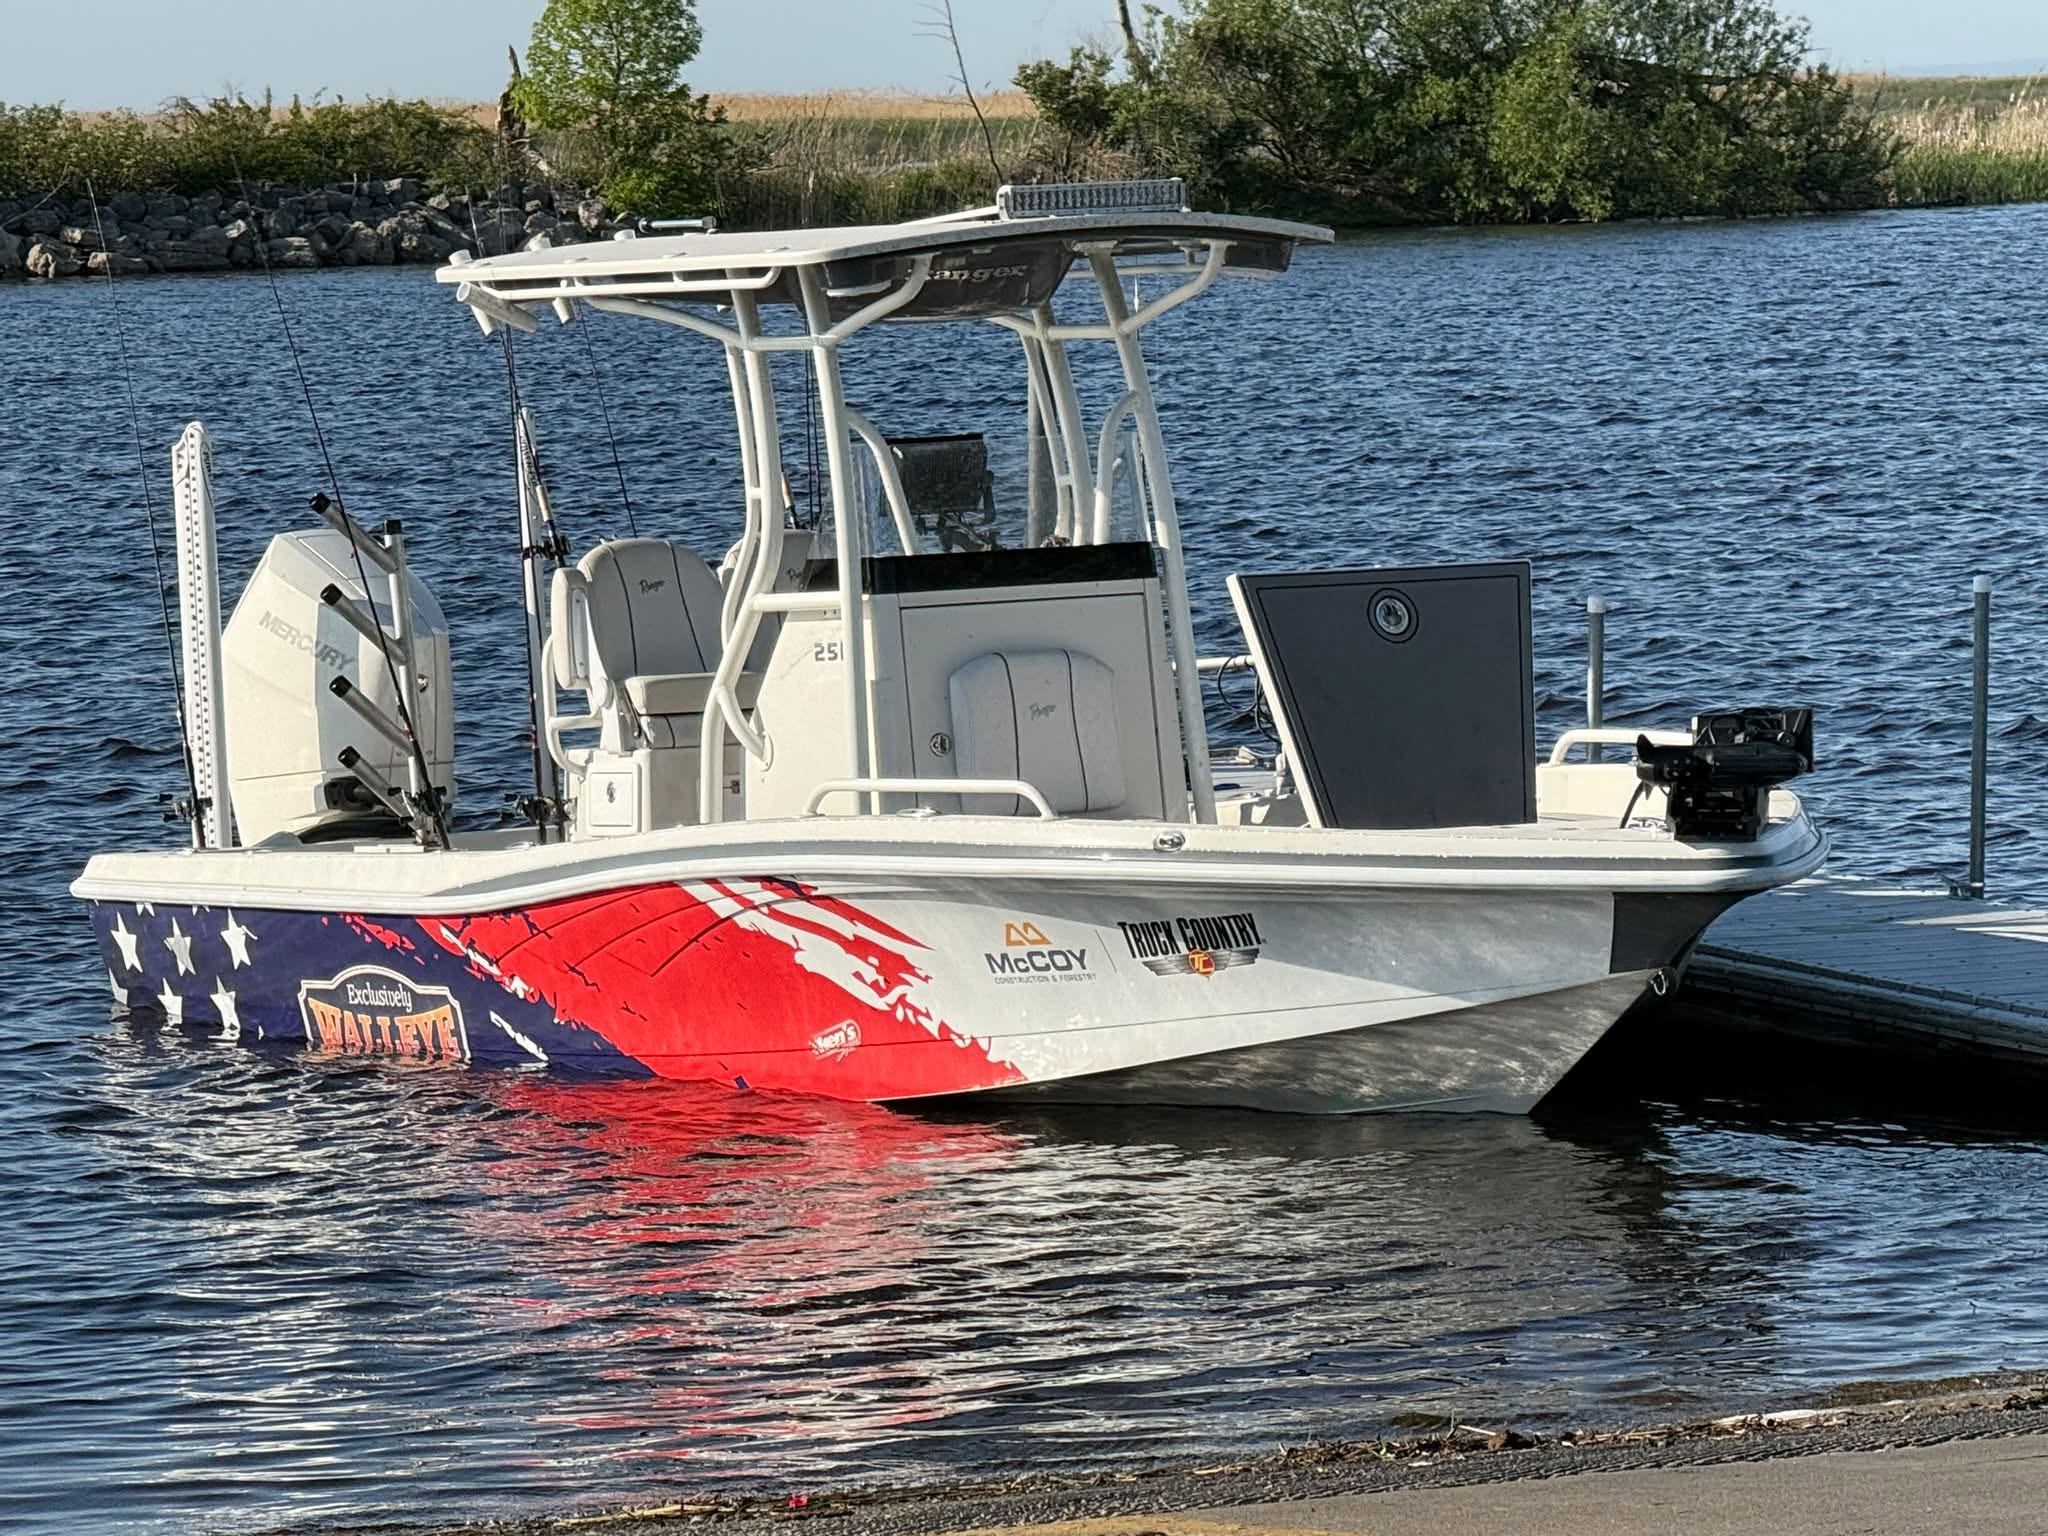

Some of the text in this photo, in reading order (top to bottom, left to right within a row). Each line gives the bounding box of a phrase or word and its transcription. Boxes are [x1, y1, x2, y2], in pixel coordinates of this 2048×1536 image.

[259, 611, 354, 670] MERCURY
[1117, 912, 1263, 959] TRUCK COUNTRY
[984, 948, 1088, 975] McCOY
[994, 975, 1049, 985] CONSTRUCTION
[1059, 973, 1097, 983] FORESTRY
[345, 981, 413, 1012] Exclusively
